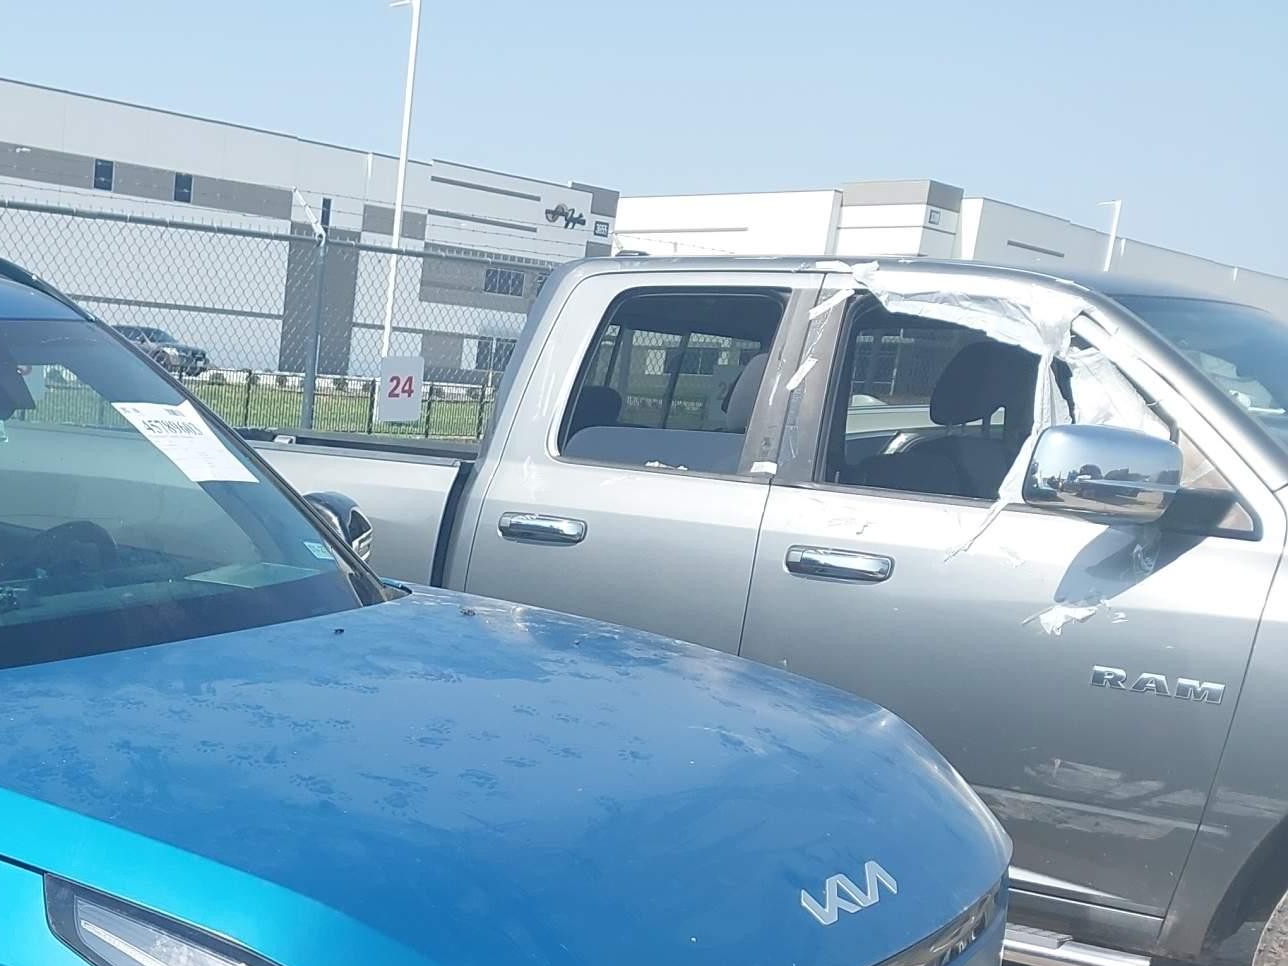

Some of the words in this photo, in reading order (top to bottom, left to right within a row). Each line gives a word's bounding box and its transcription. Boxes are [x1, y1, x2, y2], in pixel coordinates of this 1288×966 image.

[387, 375, 415, 398] 24
[1090, 664, 1226, 704] RAM
[800, 859, 898, 926] KIA
